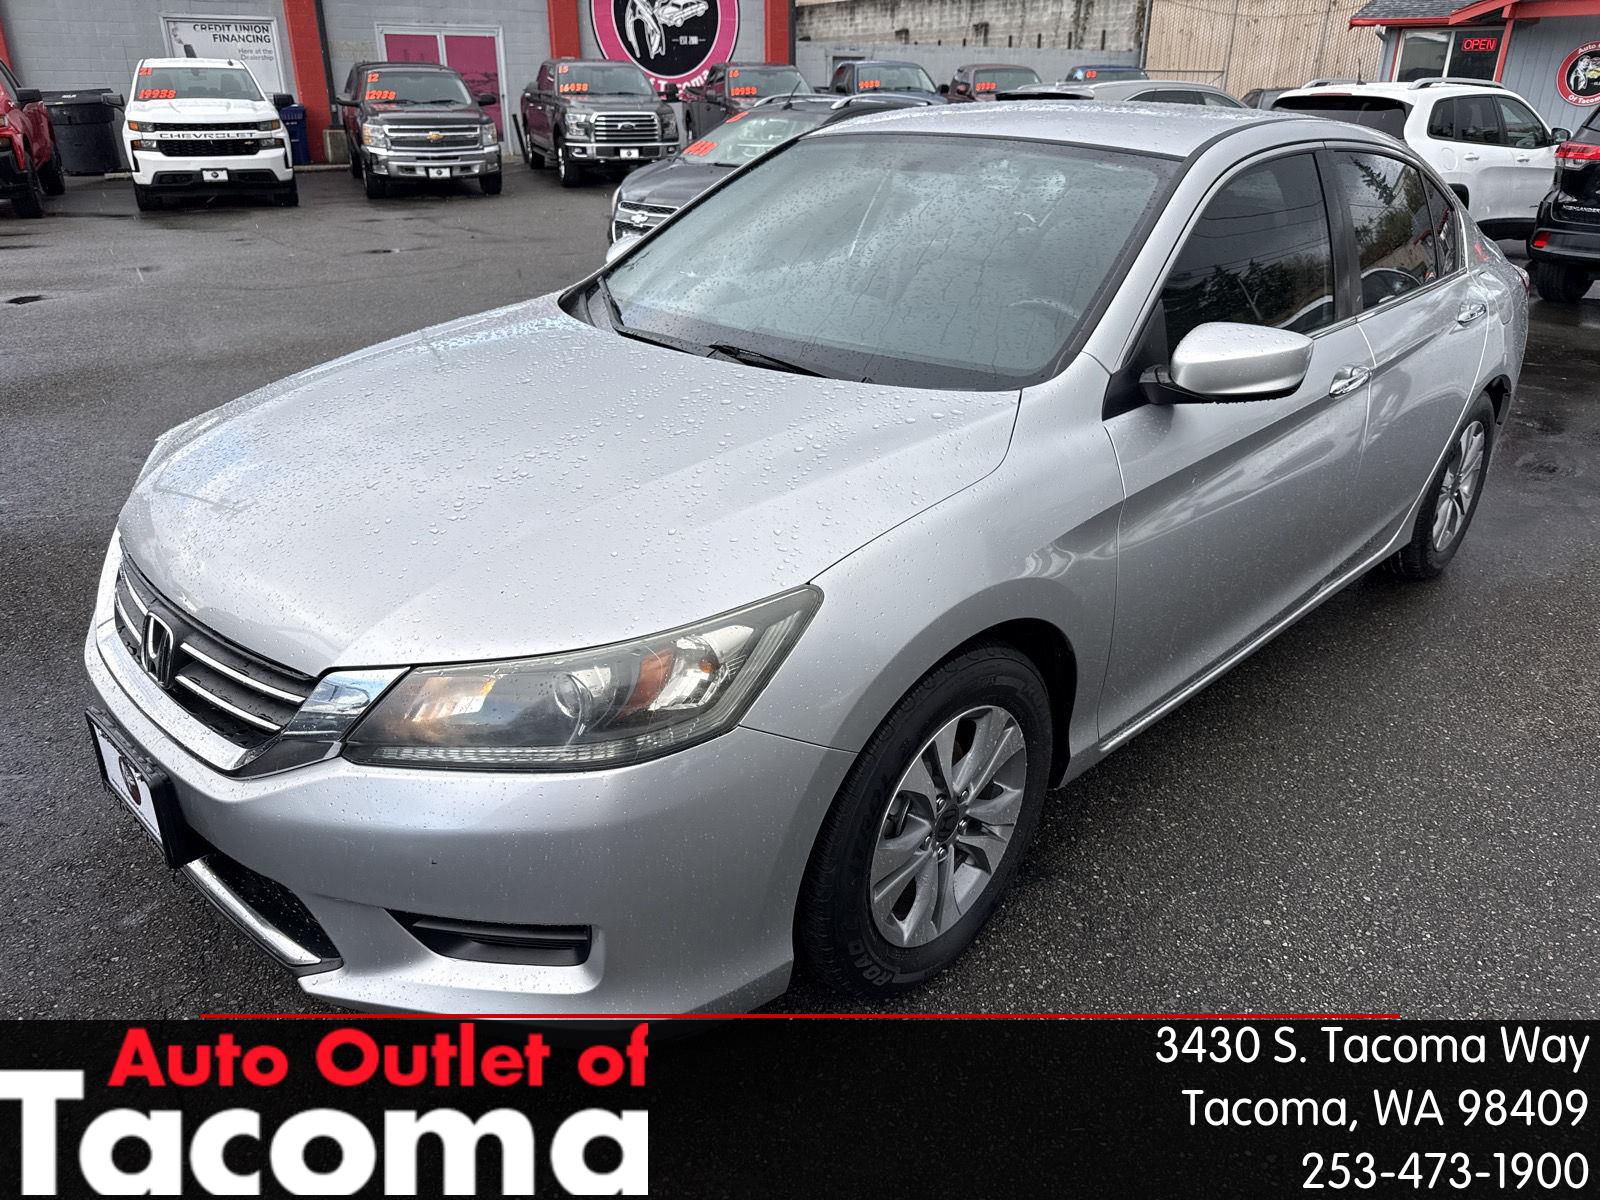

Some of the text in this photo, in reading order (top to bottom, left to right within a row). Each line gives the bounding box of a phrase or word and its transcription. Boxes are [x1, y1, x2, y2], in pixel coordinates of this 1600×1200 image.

[193, 24, 270, 33] CREDIT UNION
[212, 34, 272, 43] FINANCING
[1463, 38, 1496, 50] OPEN
[1578, 44, 1597, 54] Auto
